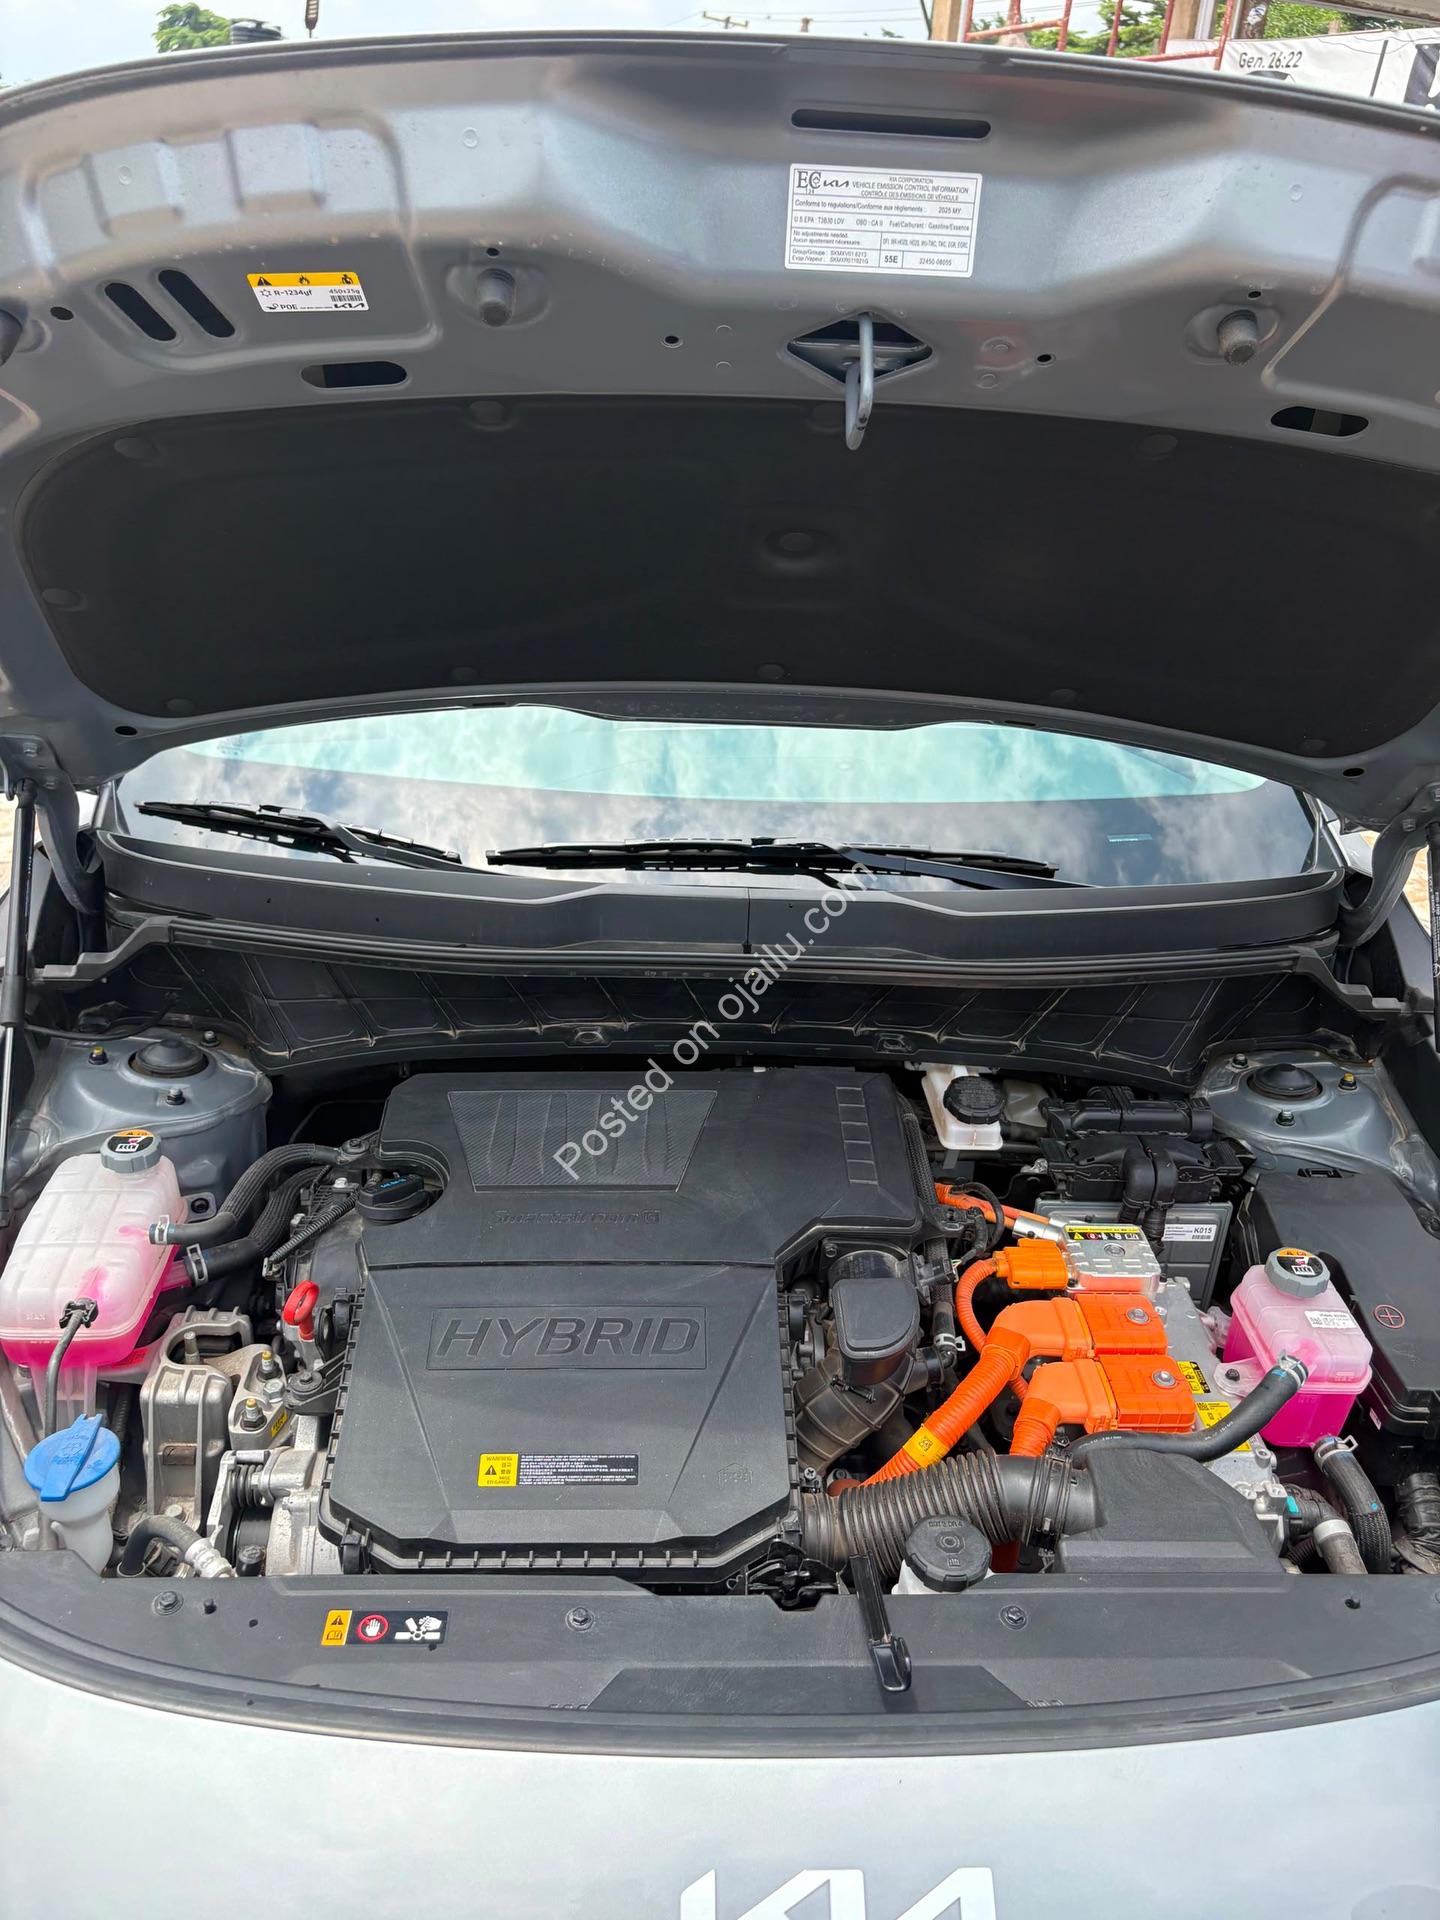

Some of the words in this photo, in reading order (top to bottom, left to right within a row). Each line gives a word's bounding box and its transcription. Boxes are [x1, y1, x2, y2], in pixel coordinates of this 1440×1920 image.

[1239, 52, 1265, 69] Gen.
[1267, 51, 1303, 68] 26:22
[852, 181, 876, 189] VEHICLE
[877, 183, 903, 191] EMISSION
[904, 184, 930, 193] CONTROL
[931, 186, 969, 194] INFORMATION
[795, 199, 820, 207] Conforms
[938, 206, 951, 214] 2025
[884, 255, 898, 264] 55E
[274, 289, 312, 297] R-1234yf
[1193, 1226, 1213, 1234] K015
[433, 1317, 701, 1358] HYBRID
